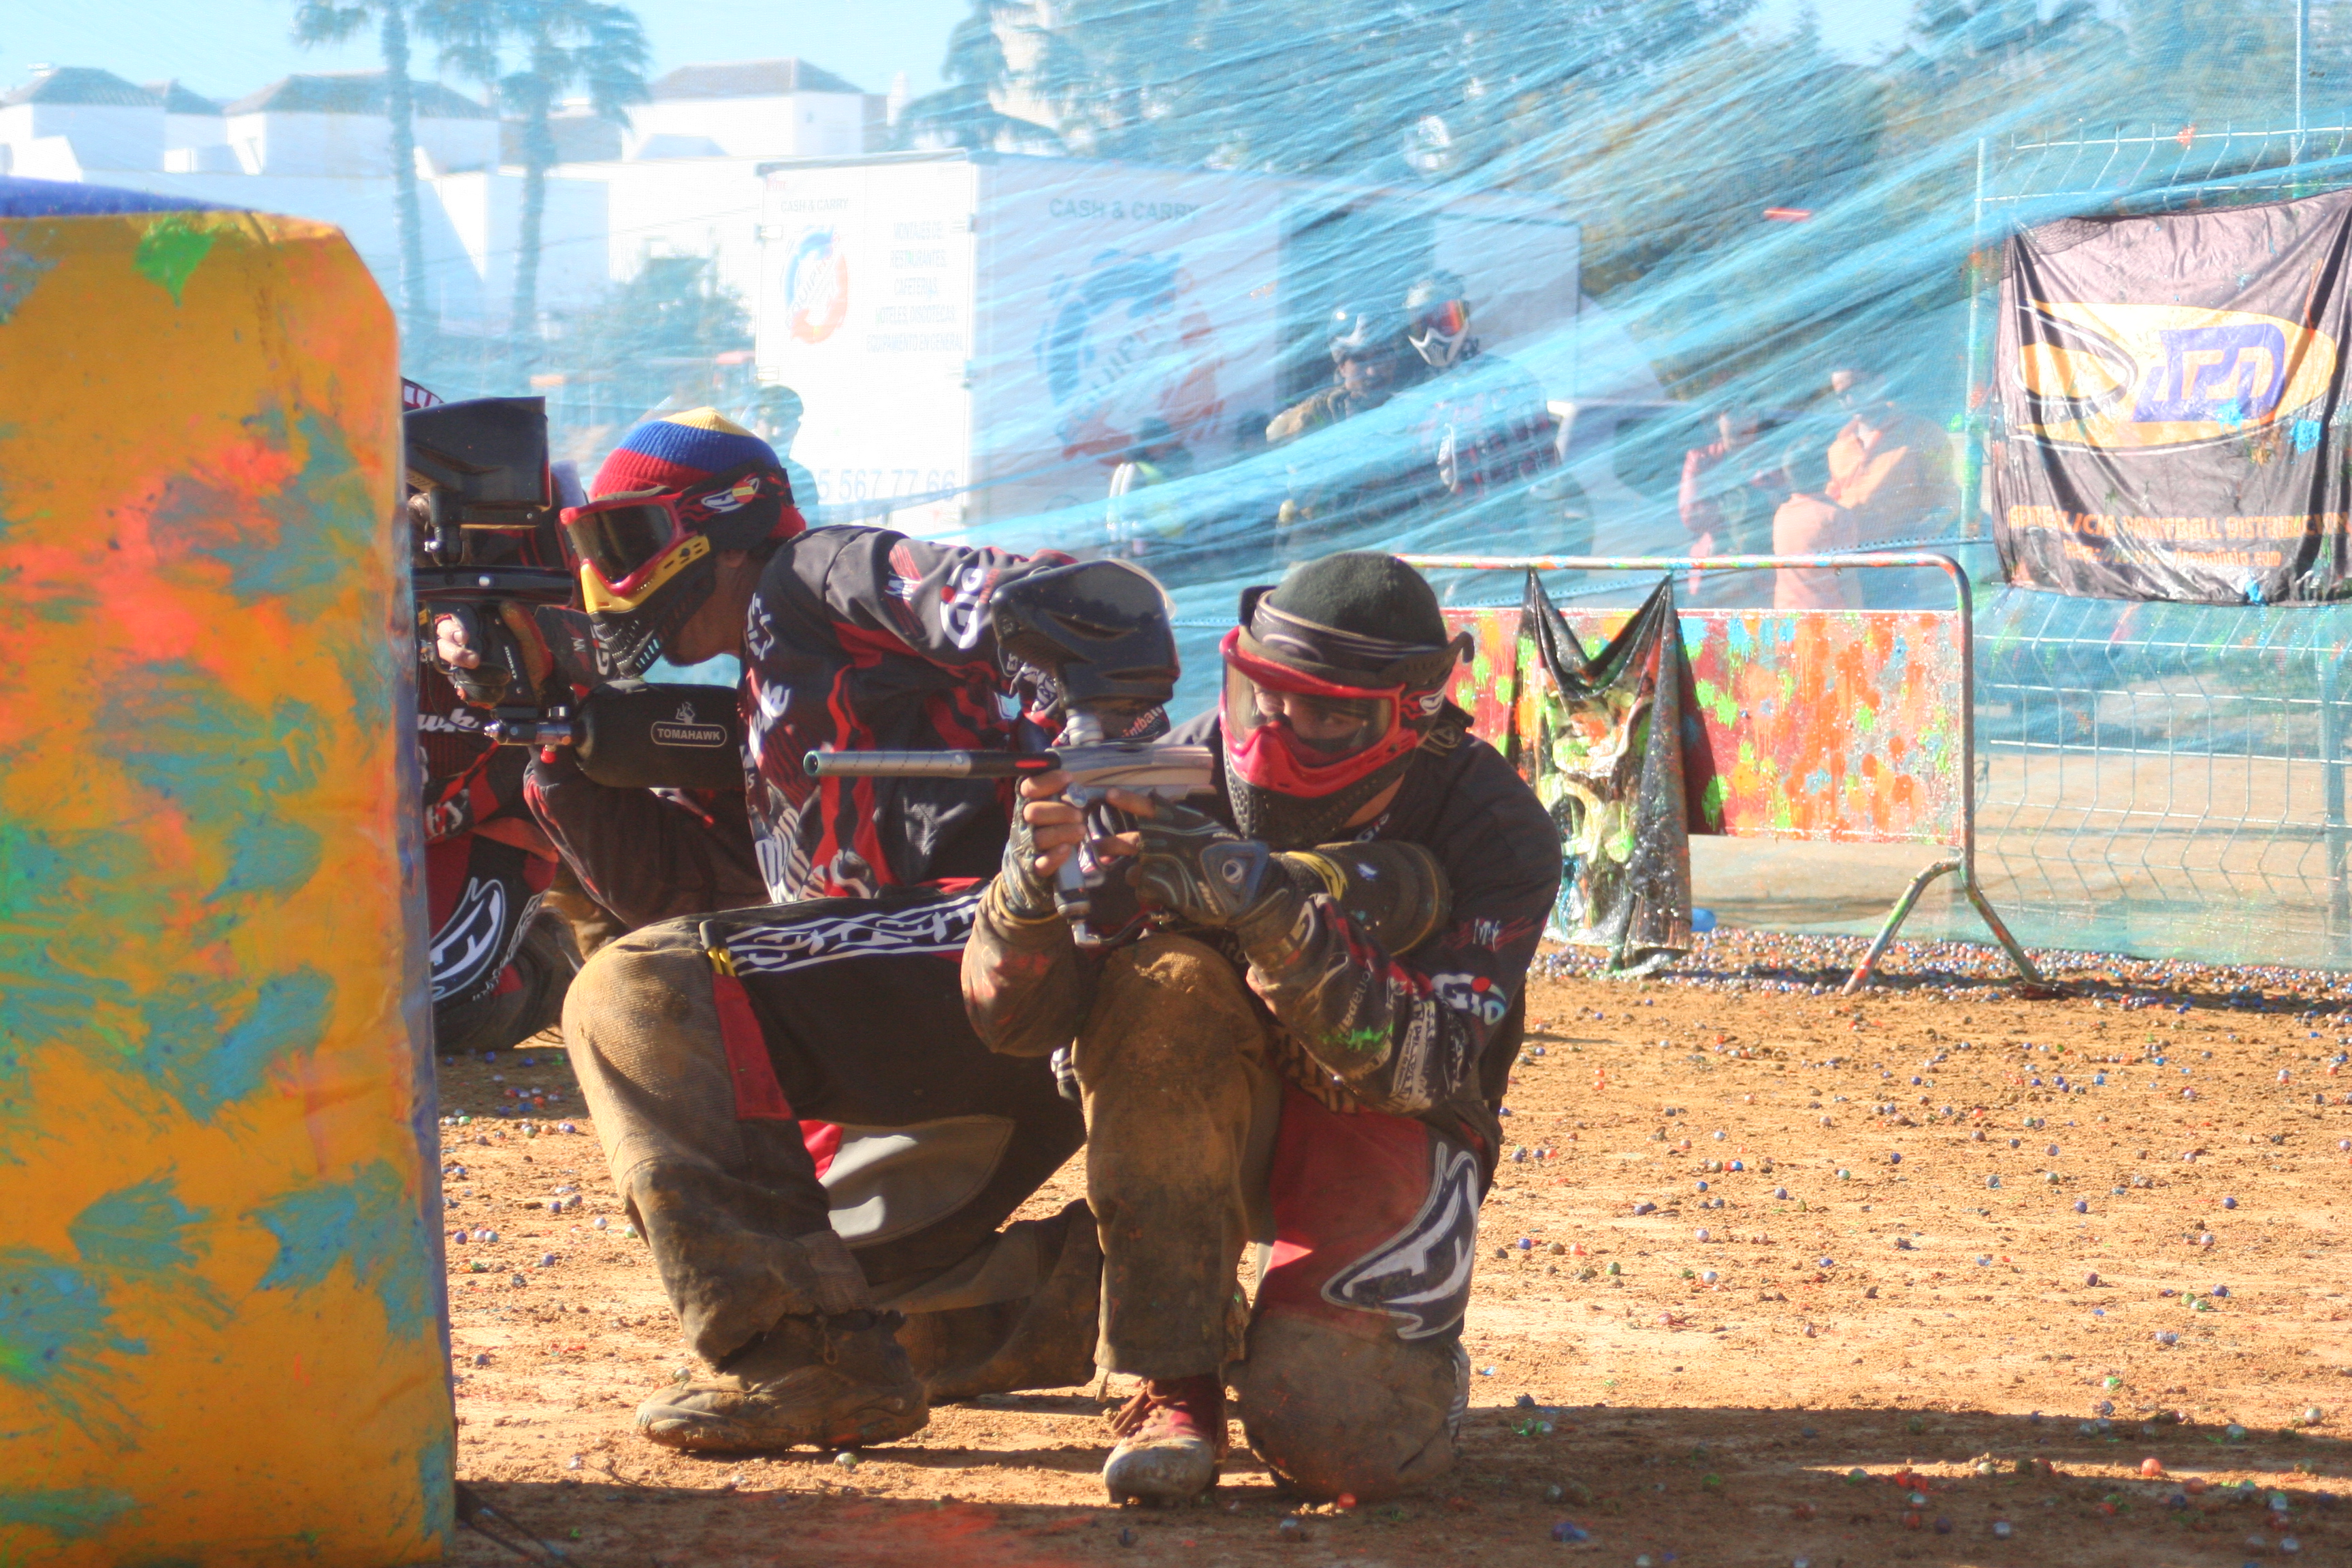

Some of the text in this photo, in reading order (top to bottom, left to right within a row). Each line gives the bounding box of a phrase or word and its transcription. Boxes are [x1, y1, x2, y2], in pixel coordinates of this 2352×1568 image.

[781, 199, 808, 212] CASH
[817, 197, 849, 212] CARRY
[1049, 198, 1202, 223] CASH & CARRY
[838, 468, 883, 502] 567
[891, 468, 919, 499] 77
[926, 468, 956, 499] 66
[657, 728, 721, 741] TOMAHAWK
